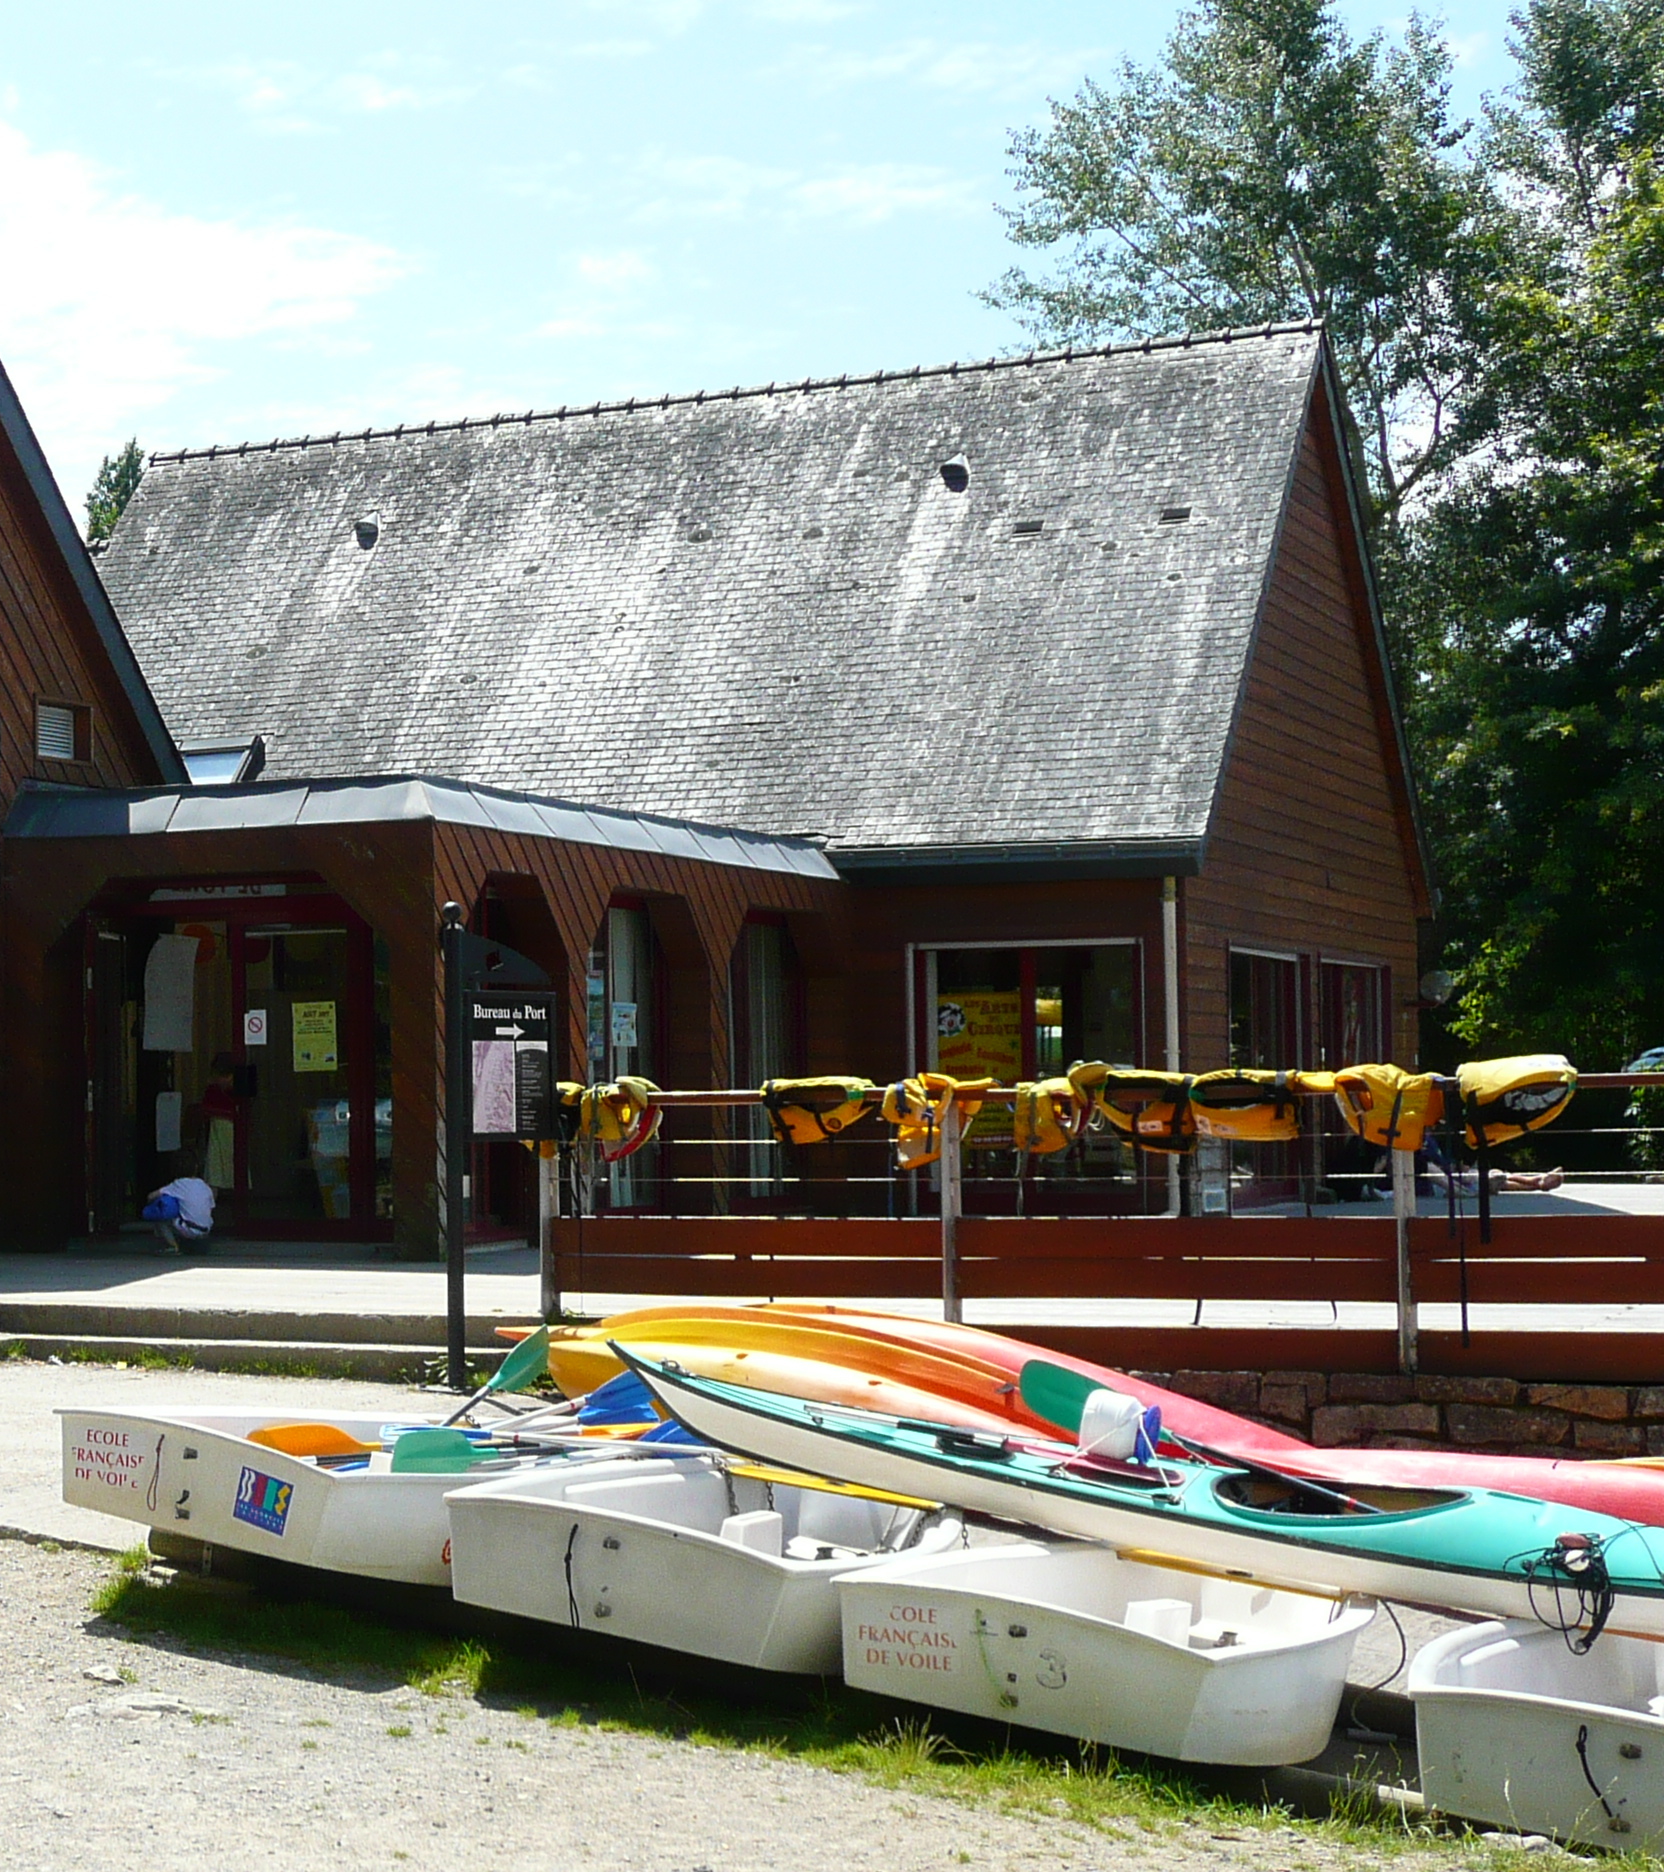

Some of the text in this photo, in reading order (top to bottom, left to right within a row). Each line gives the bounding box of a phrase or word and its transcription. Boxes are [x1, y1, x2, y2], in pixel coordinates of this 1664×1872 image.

[473, 1004, 546, 1020] Bureau du Port
[86, 1429, 129, 1447] ECOLE
[866, 1648, 952, 1672] DE VOILE
